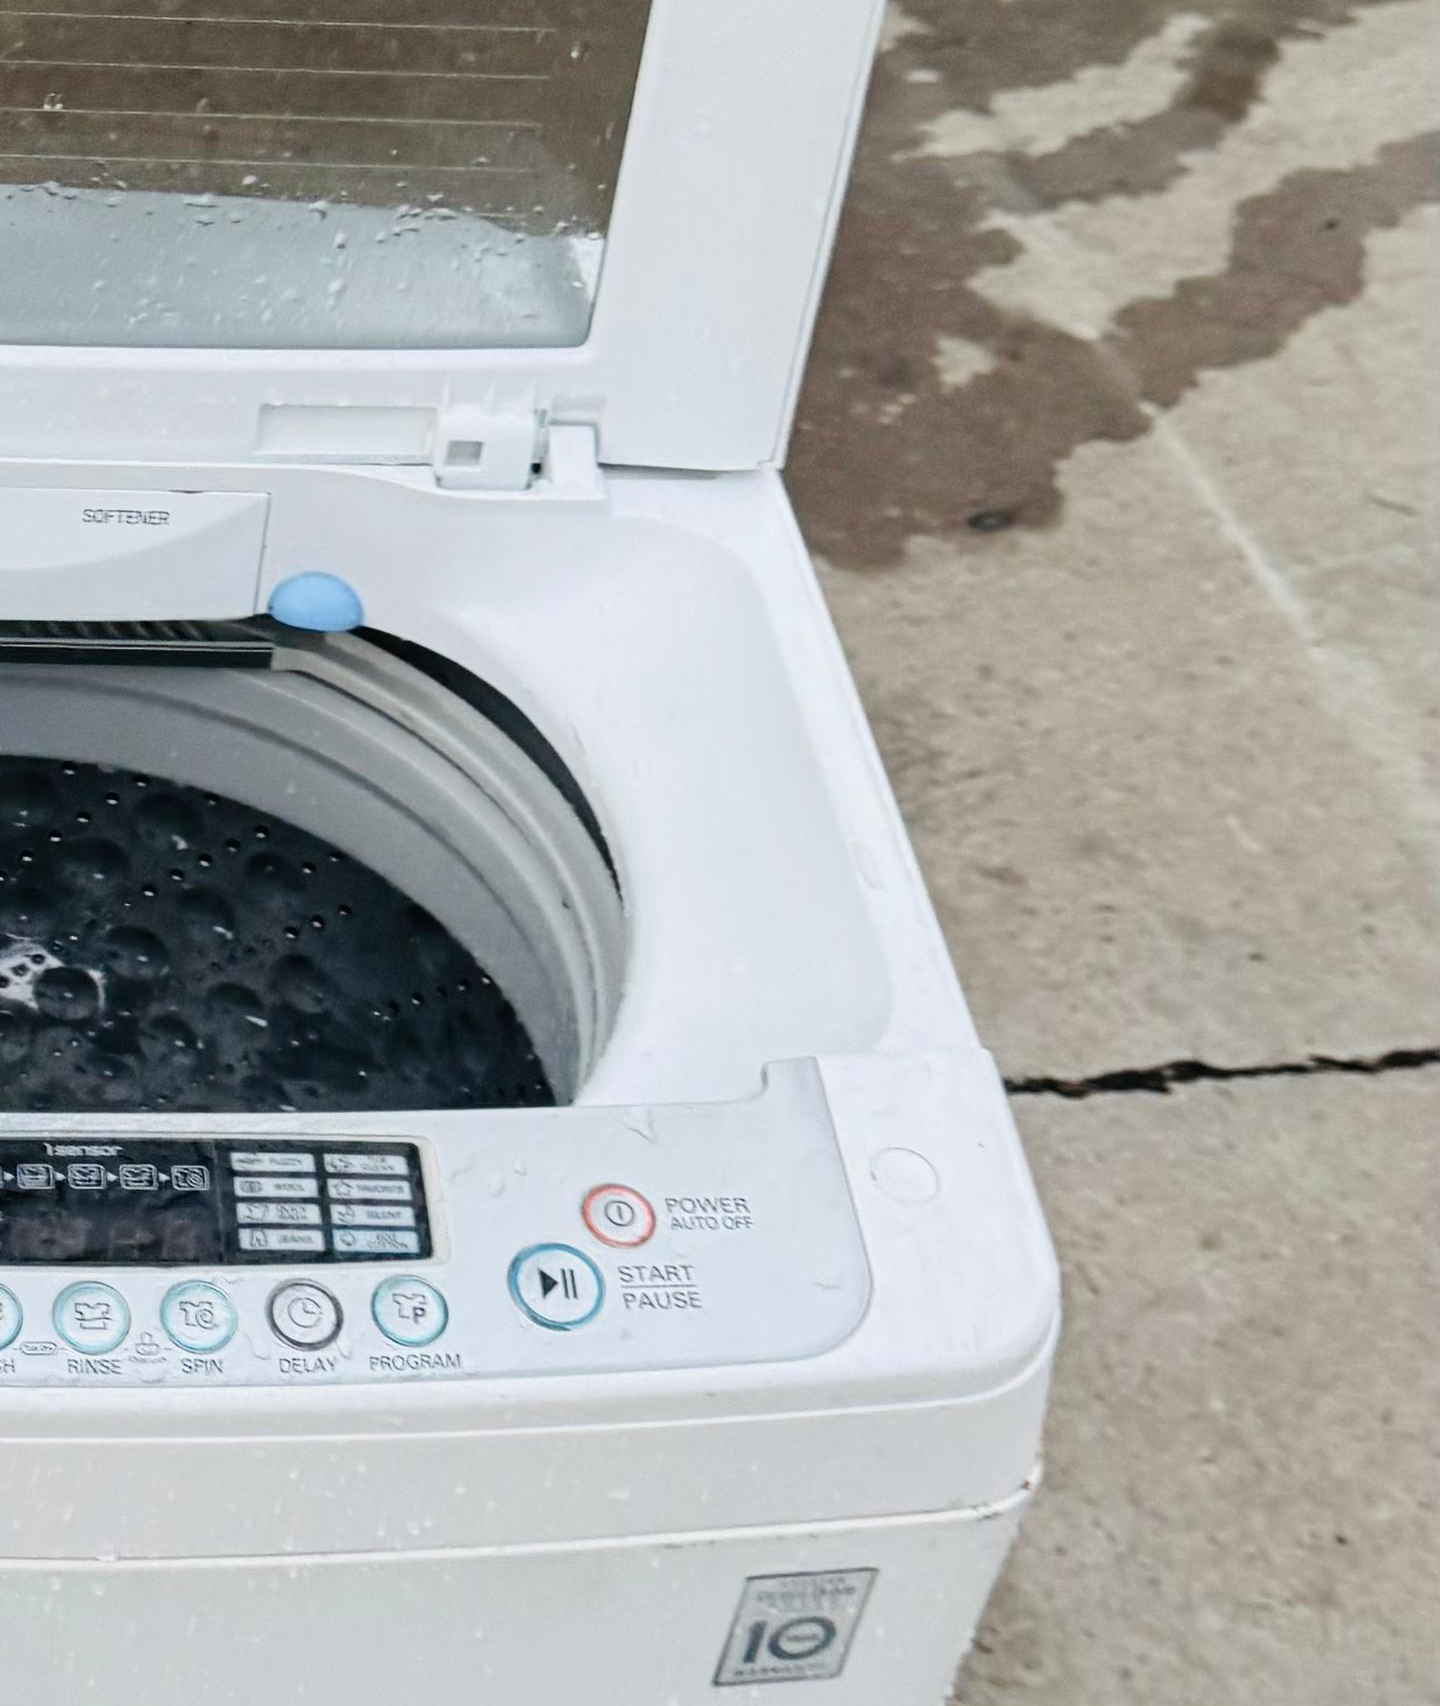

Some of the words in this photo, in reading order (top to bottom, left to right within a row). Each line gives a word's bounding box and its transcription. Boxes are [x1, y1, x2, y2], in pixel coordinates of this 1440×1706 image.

[82, 508, 170, 525] SOFTENER
[665, 1196, 750, 1215] POWER
[670, 1216, 719, 1230] AUTO
[724, 1215, 754, 1230] OFF
[619, 1264, 695, 1284] START
[624, 1291, 703, 1310] PAUSE
[67, 1359, 123, 1375] RINSE
[181, 1358, 224, 1374] SPIN
[278, 1356, 338, 1374] DELAY
[369, 1353, 463, 1372] PROGRAM
